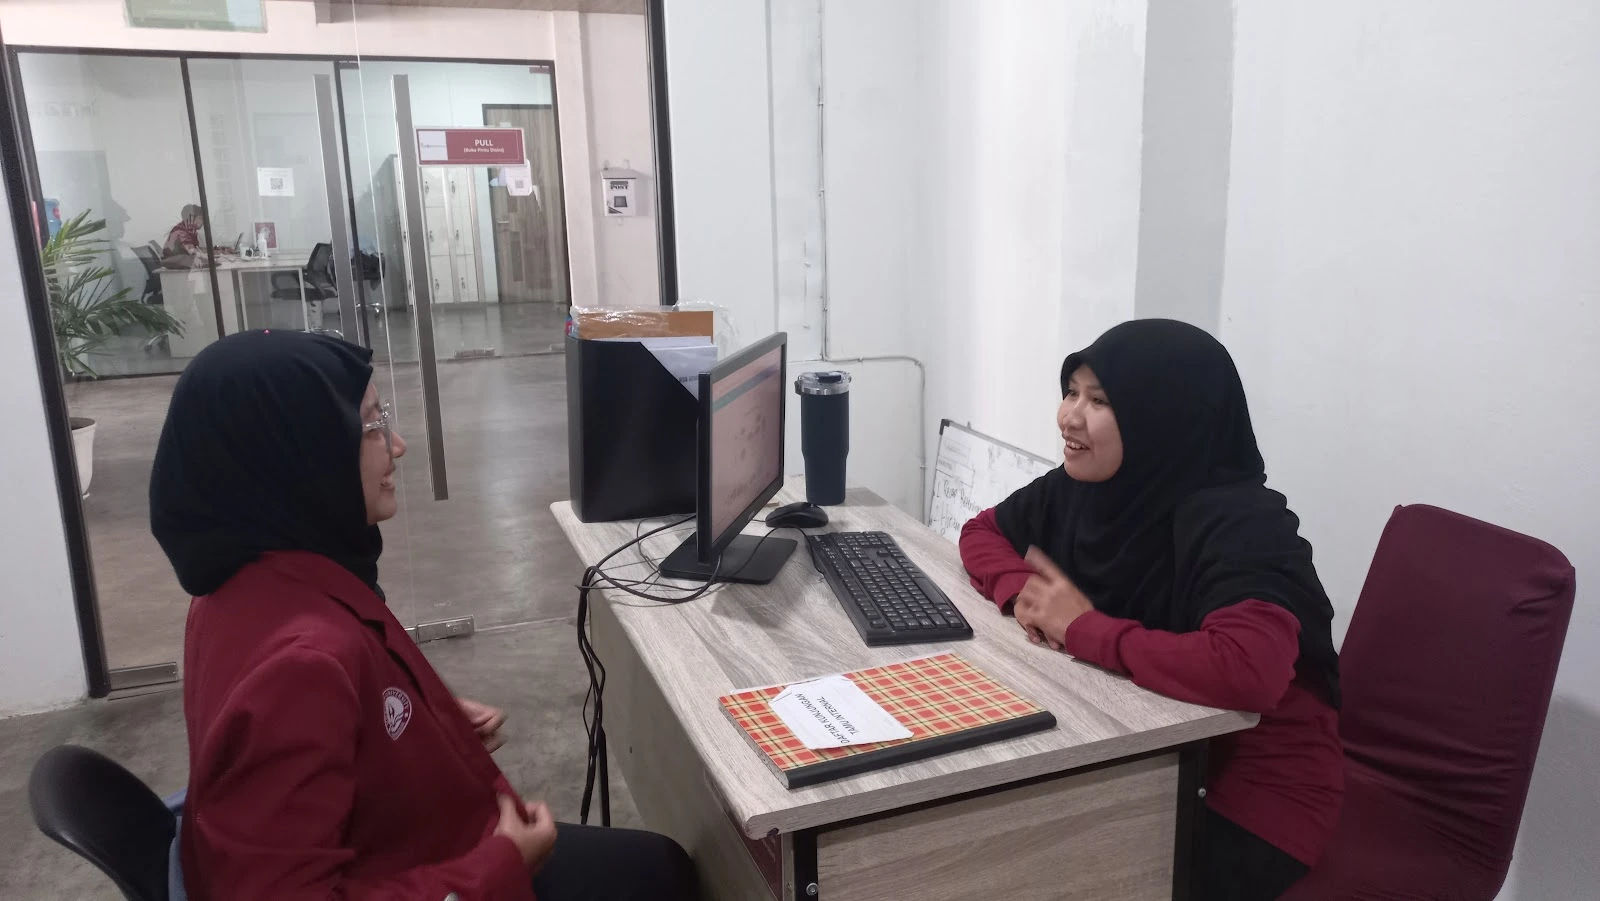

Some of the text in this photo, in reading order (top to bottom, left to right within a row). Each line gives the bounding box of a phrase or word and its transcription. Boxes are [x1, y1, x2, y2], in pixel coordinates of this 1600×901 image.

[474, 139, 494, 147] PULL
[795, 693, 850, 744] DAFTAR KUNJUNGAN
[816, 696, 859, 735] TAMU INTERNAL
